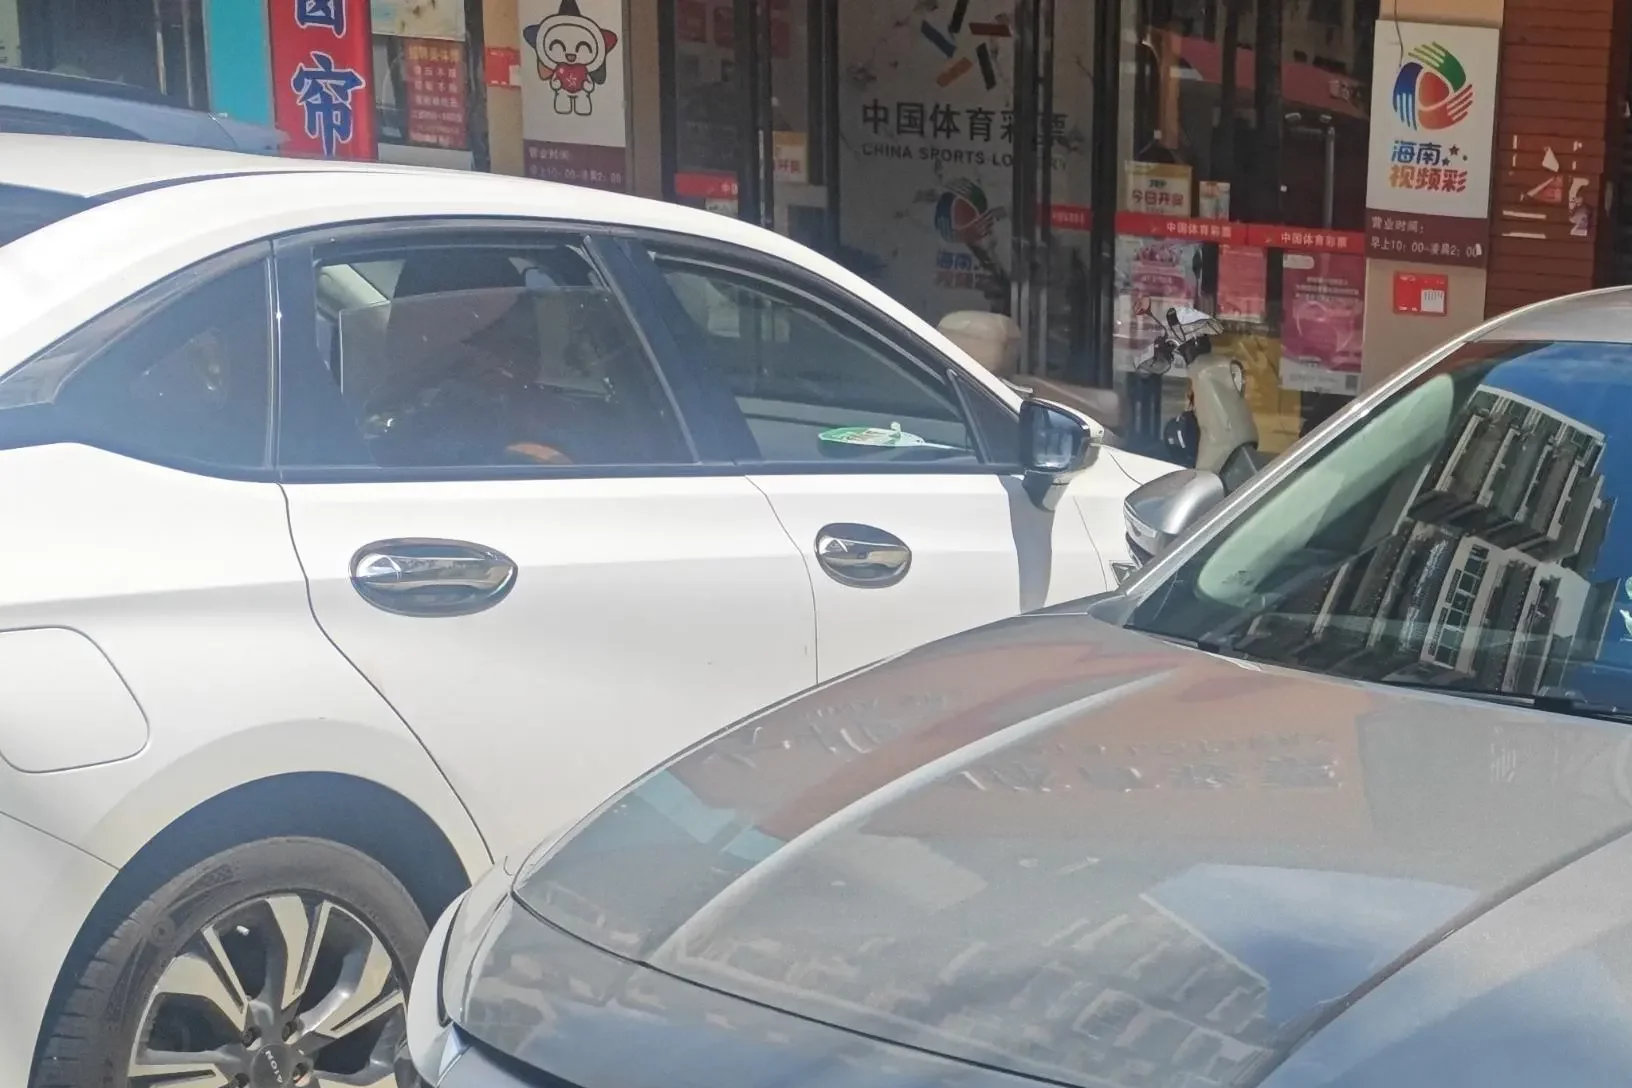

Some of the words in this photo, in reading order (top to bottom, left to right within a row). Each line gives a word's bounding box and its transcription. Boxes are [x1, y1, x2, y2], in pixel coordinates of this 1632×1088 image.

[862, 143, 913, 159] CHINA
[919, 147, 985, 166] SPORTS
[1390, 139, 1441, 165] 海南
[1389, 166, 1468, 193] 视频彩
